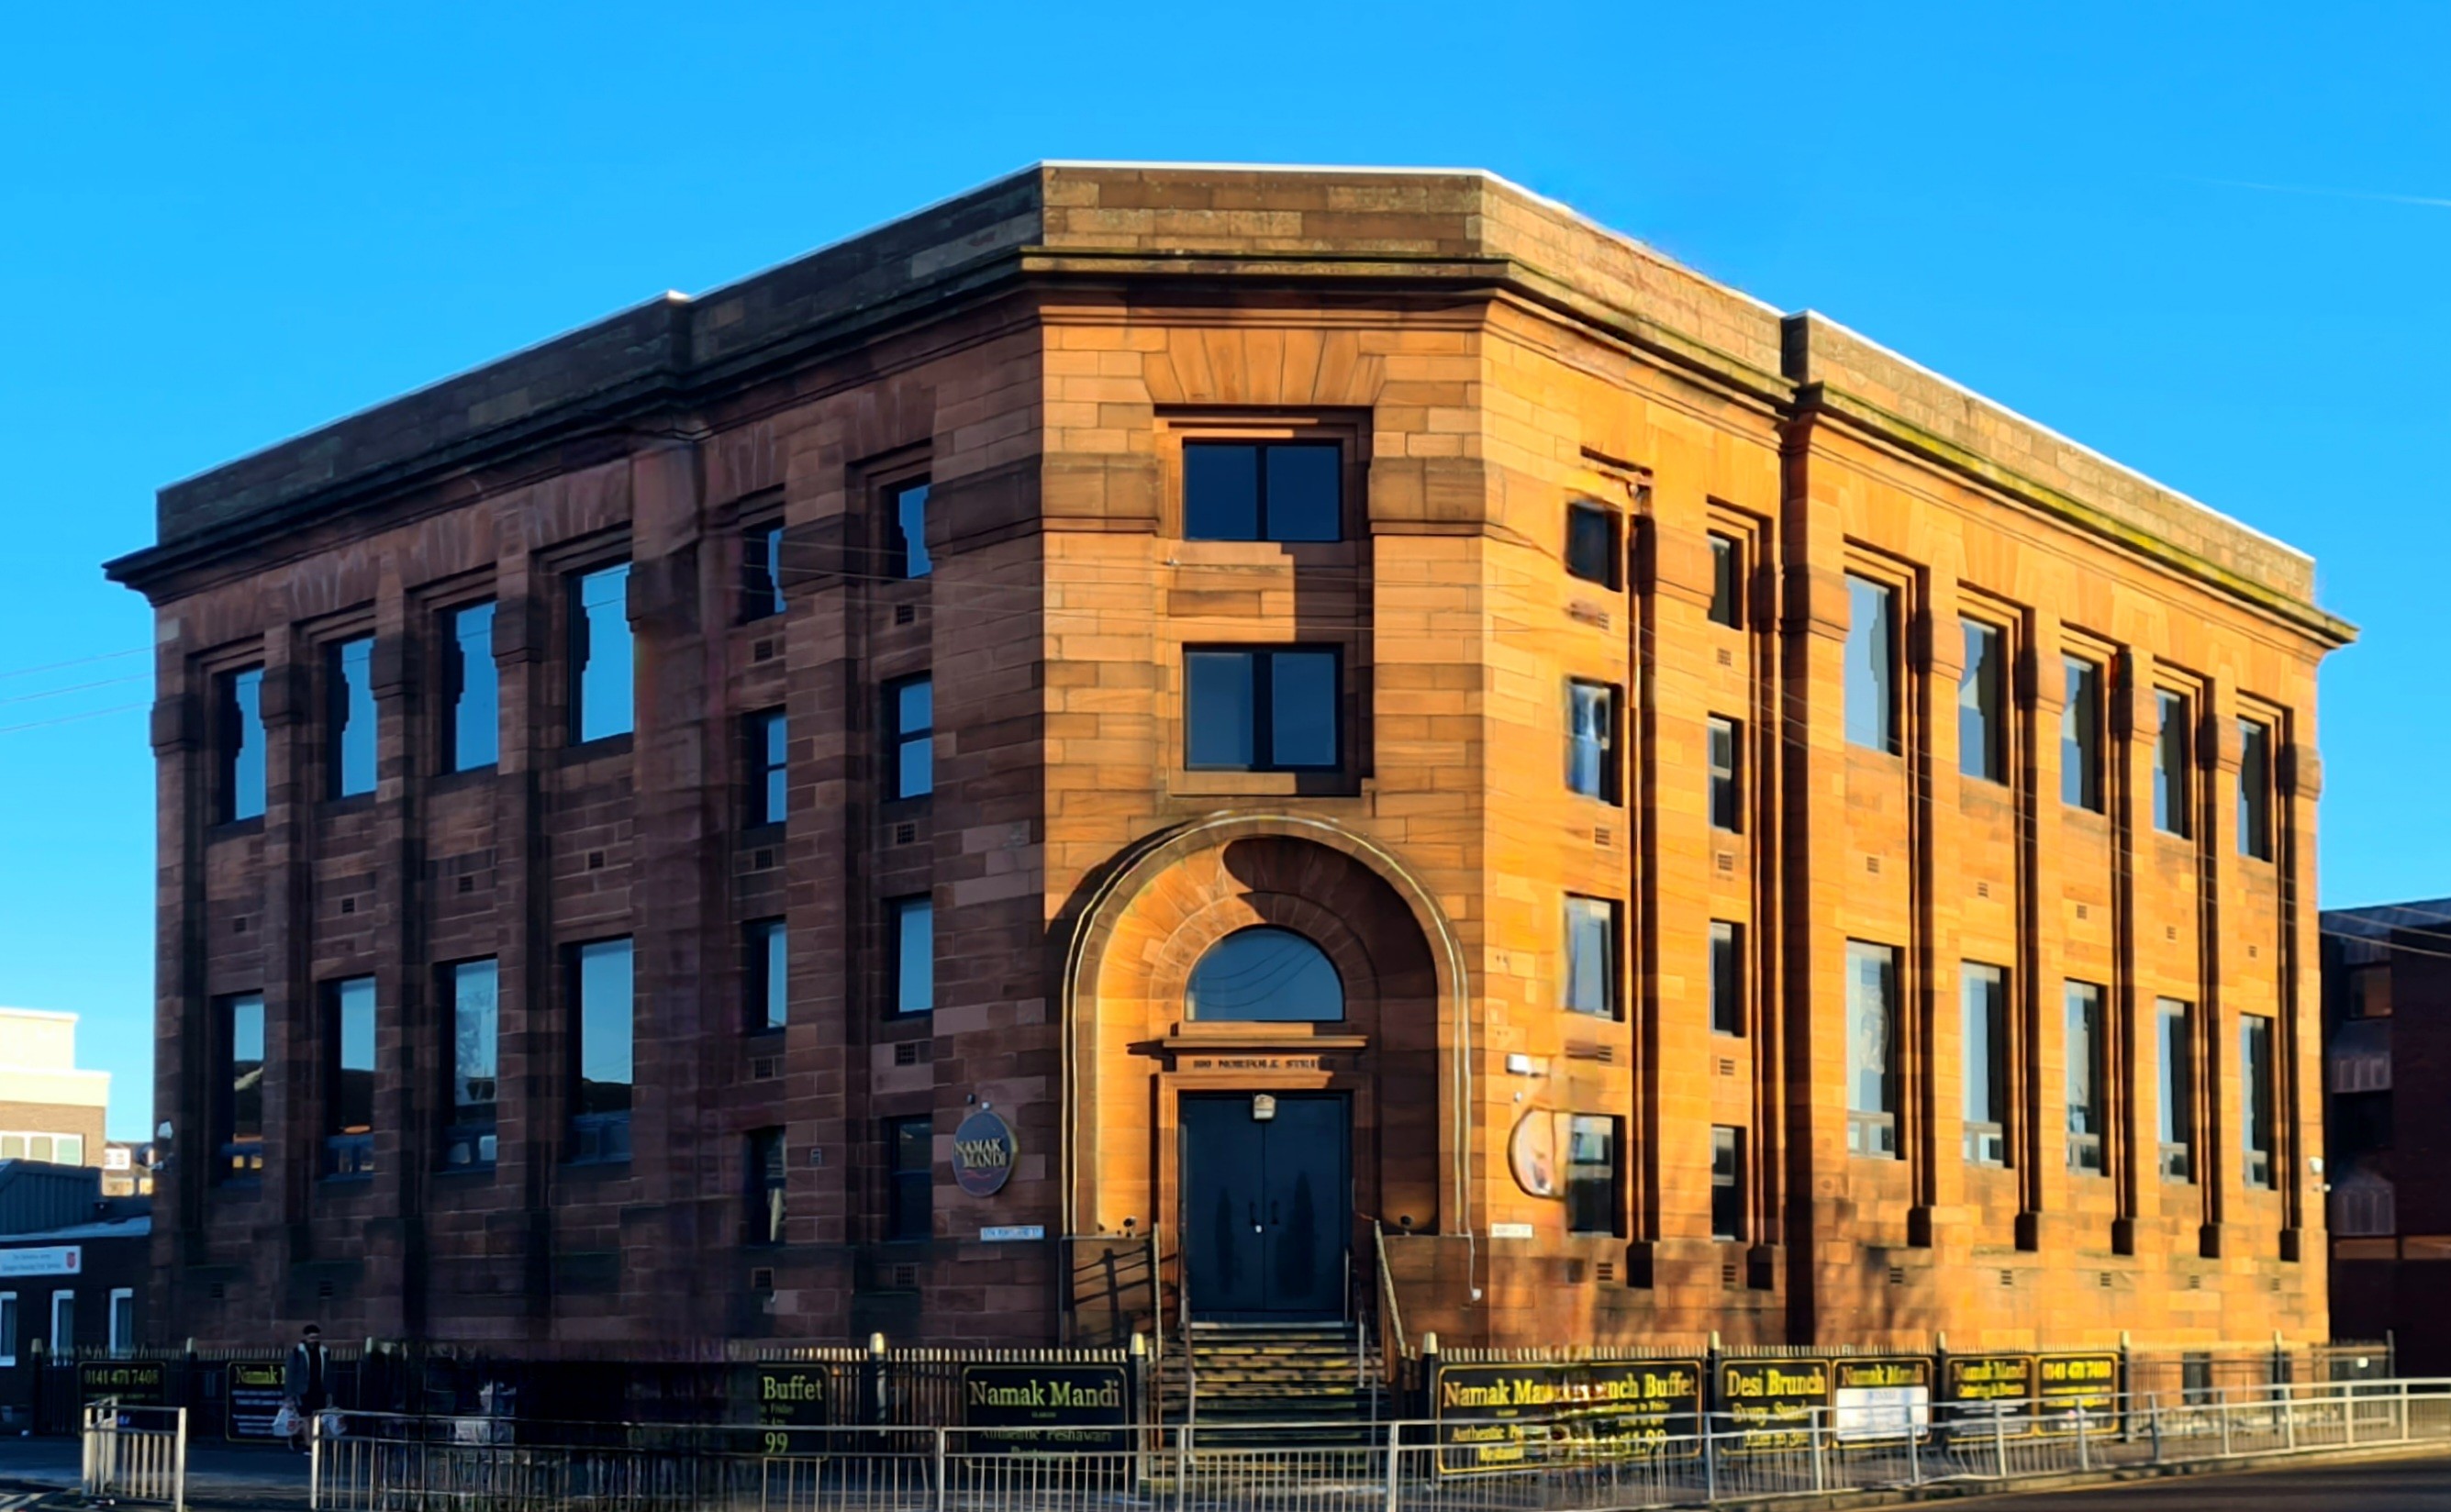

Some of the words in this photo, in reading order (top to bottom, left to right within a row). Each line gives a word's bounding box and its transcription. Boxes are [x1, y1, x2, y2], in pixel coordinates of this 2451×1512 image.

[954, 1138, 1001, 1156] NAMAK
[763, 1374, 823, 1401] Buffet
[1643, 1371, 1697, 1397] Buffet
[1726, 1369, 1764, 1396] Desi
[1766, 1366, 1826, 1395] Brunch
[1841, 1364, 1885, 1386] Namak
[968, 1380, 1045, 1406] Namak
[1048, 1379, 1120, 1407] Mandi
[1443, 1378, 1510, 1406] Namak
[1451, 1424, 1505, 1441] Authentic
